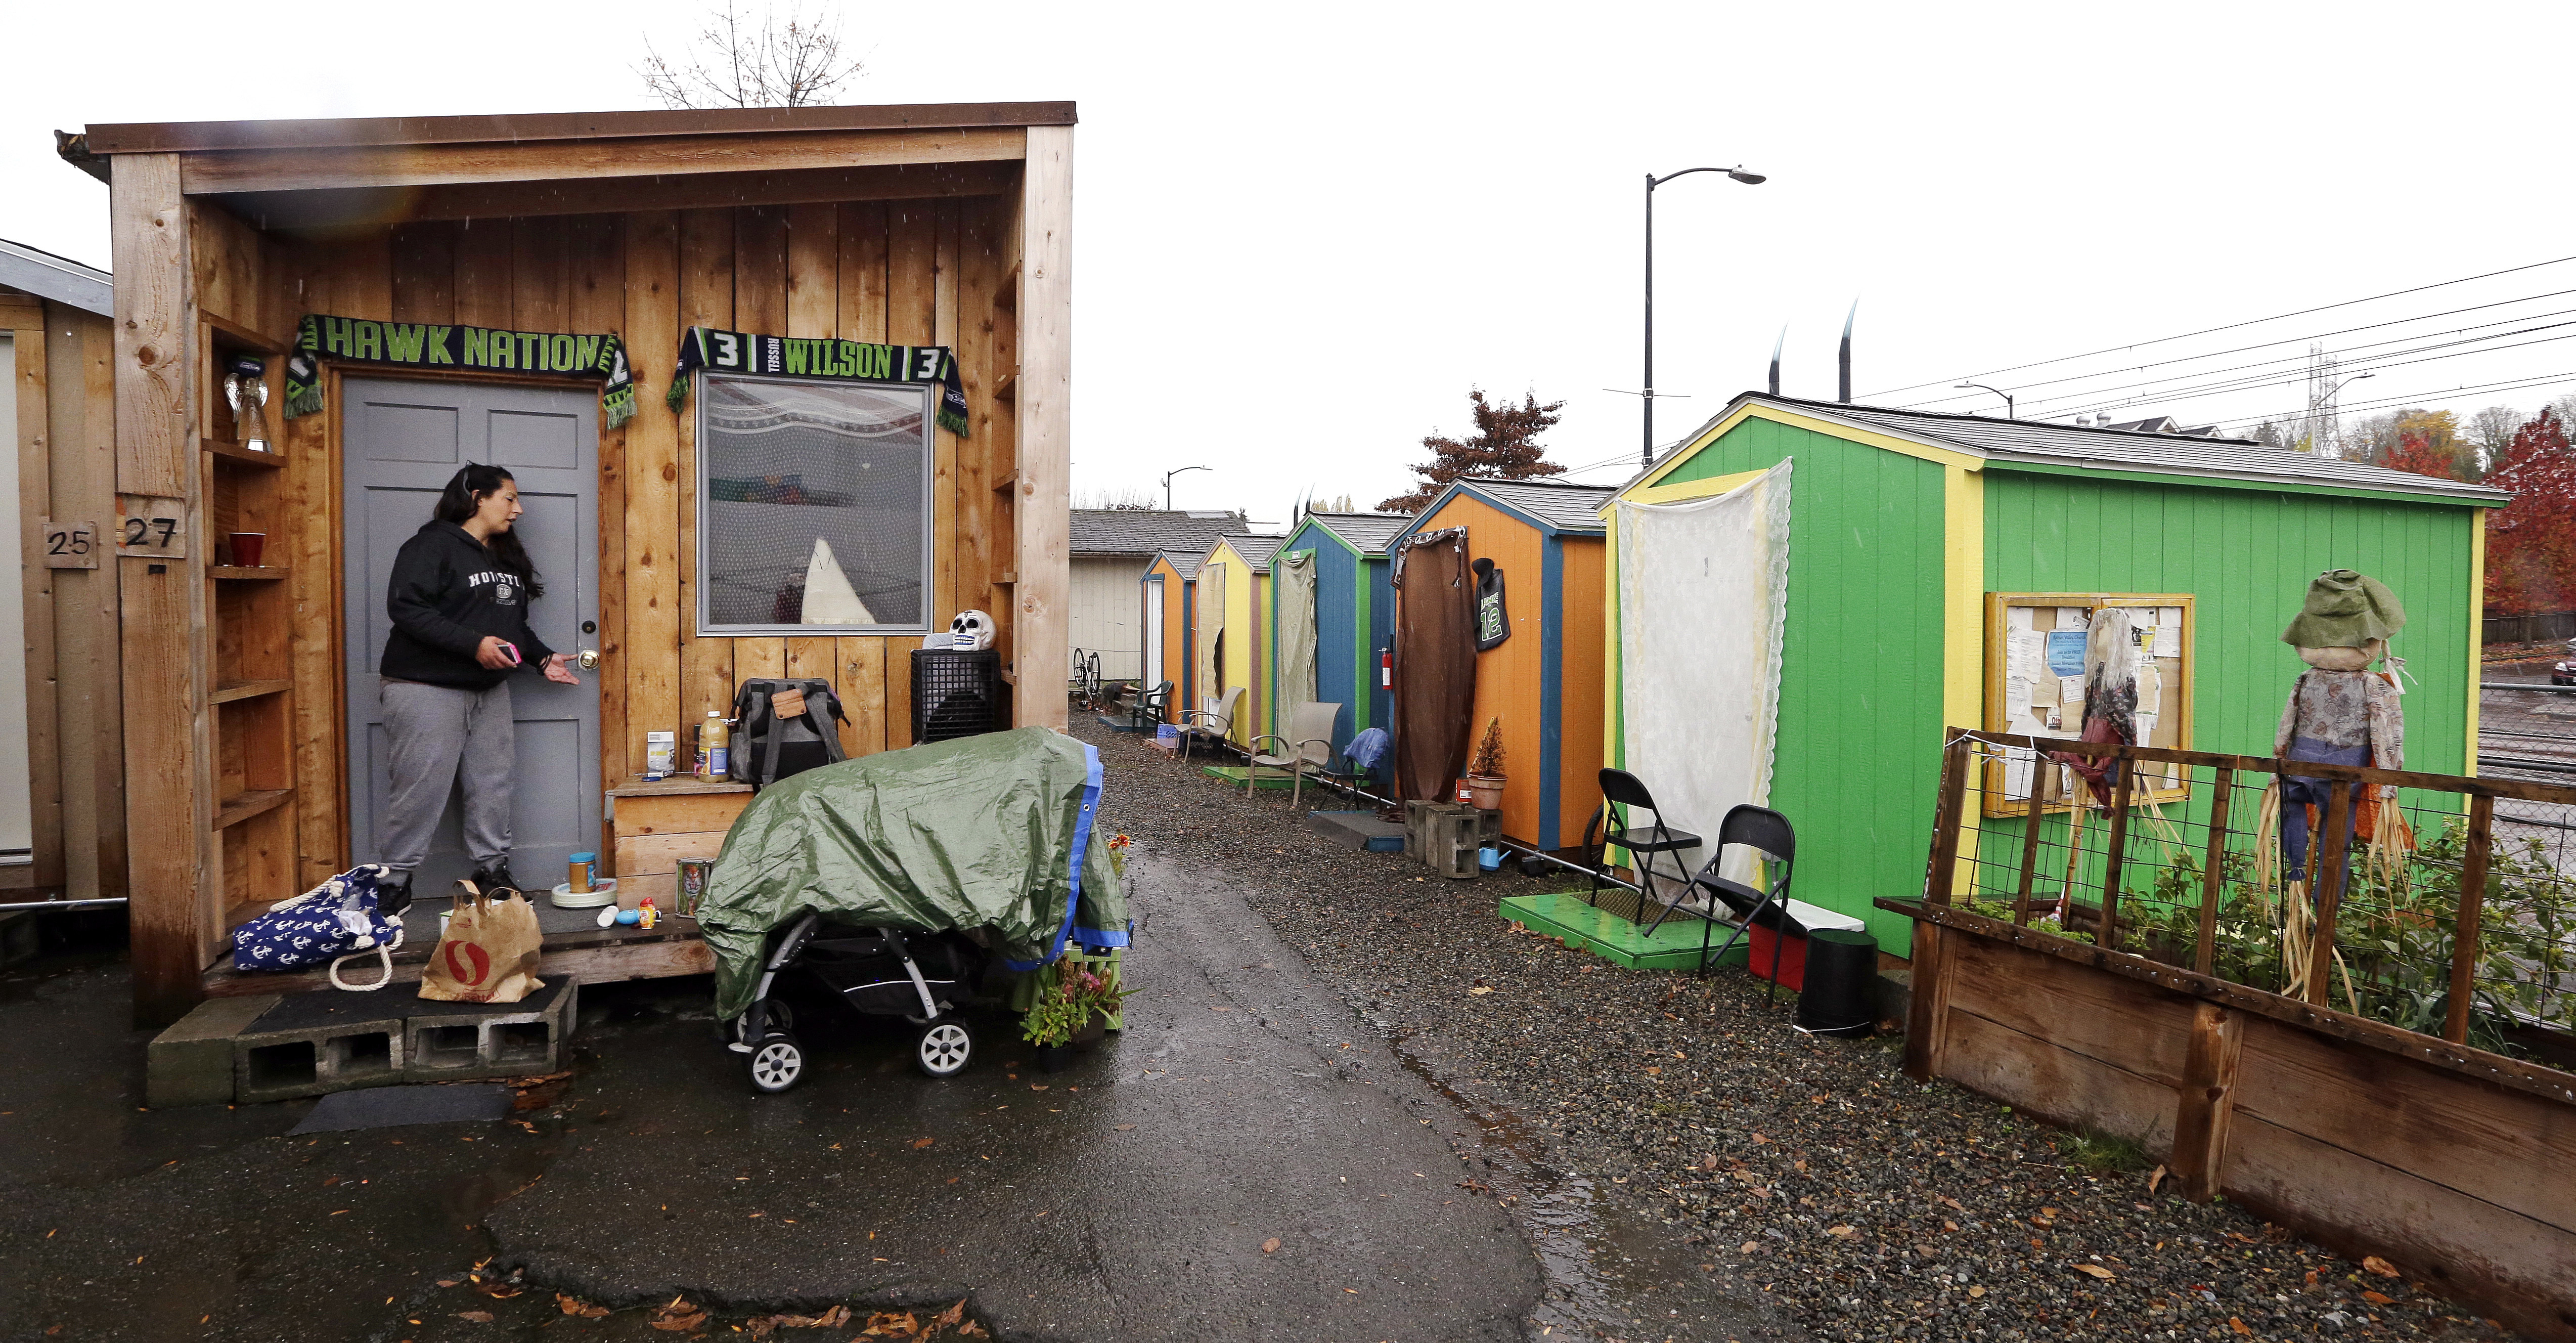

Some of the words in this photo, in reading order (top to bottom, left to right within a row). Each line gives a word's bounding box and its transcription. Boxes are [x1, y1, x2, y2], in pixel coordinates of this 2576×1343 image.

[325, 317, 454, 364] HAWK
[464, 327, 599, 371] NATION
[714, 333, 738, 367] 3
[768, 338, 780, 372] RUSSELL
[783, 338, 893, 379] WILSON
[917, 349, 940, 378] 3
[48, 531, 90, 555] 25
[125, 517, 177, 547] 27
[1480, 608, 1503, 641] 12
